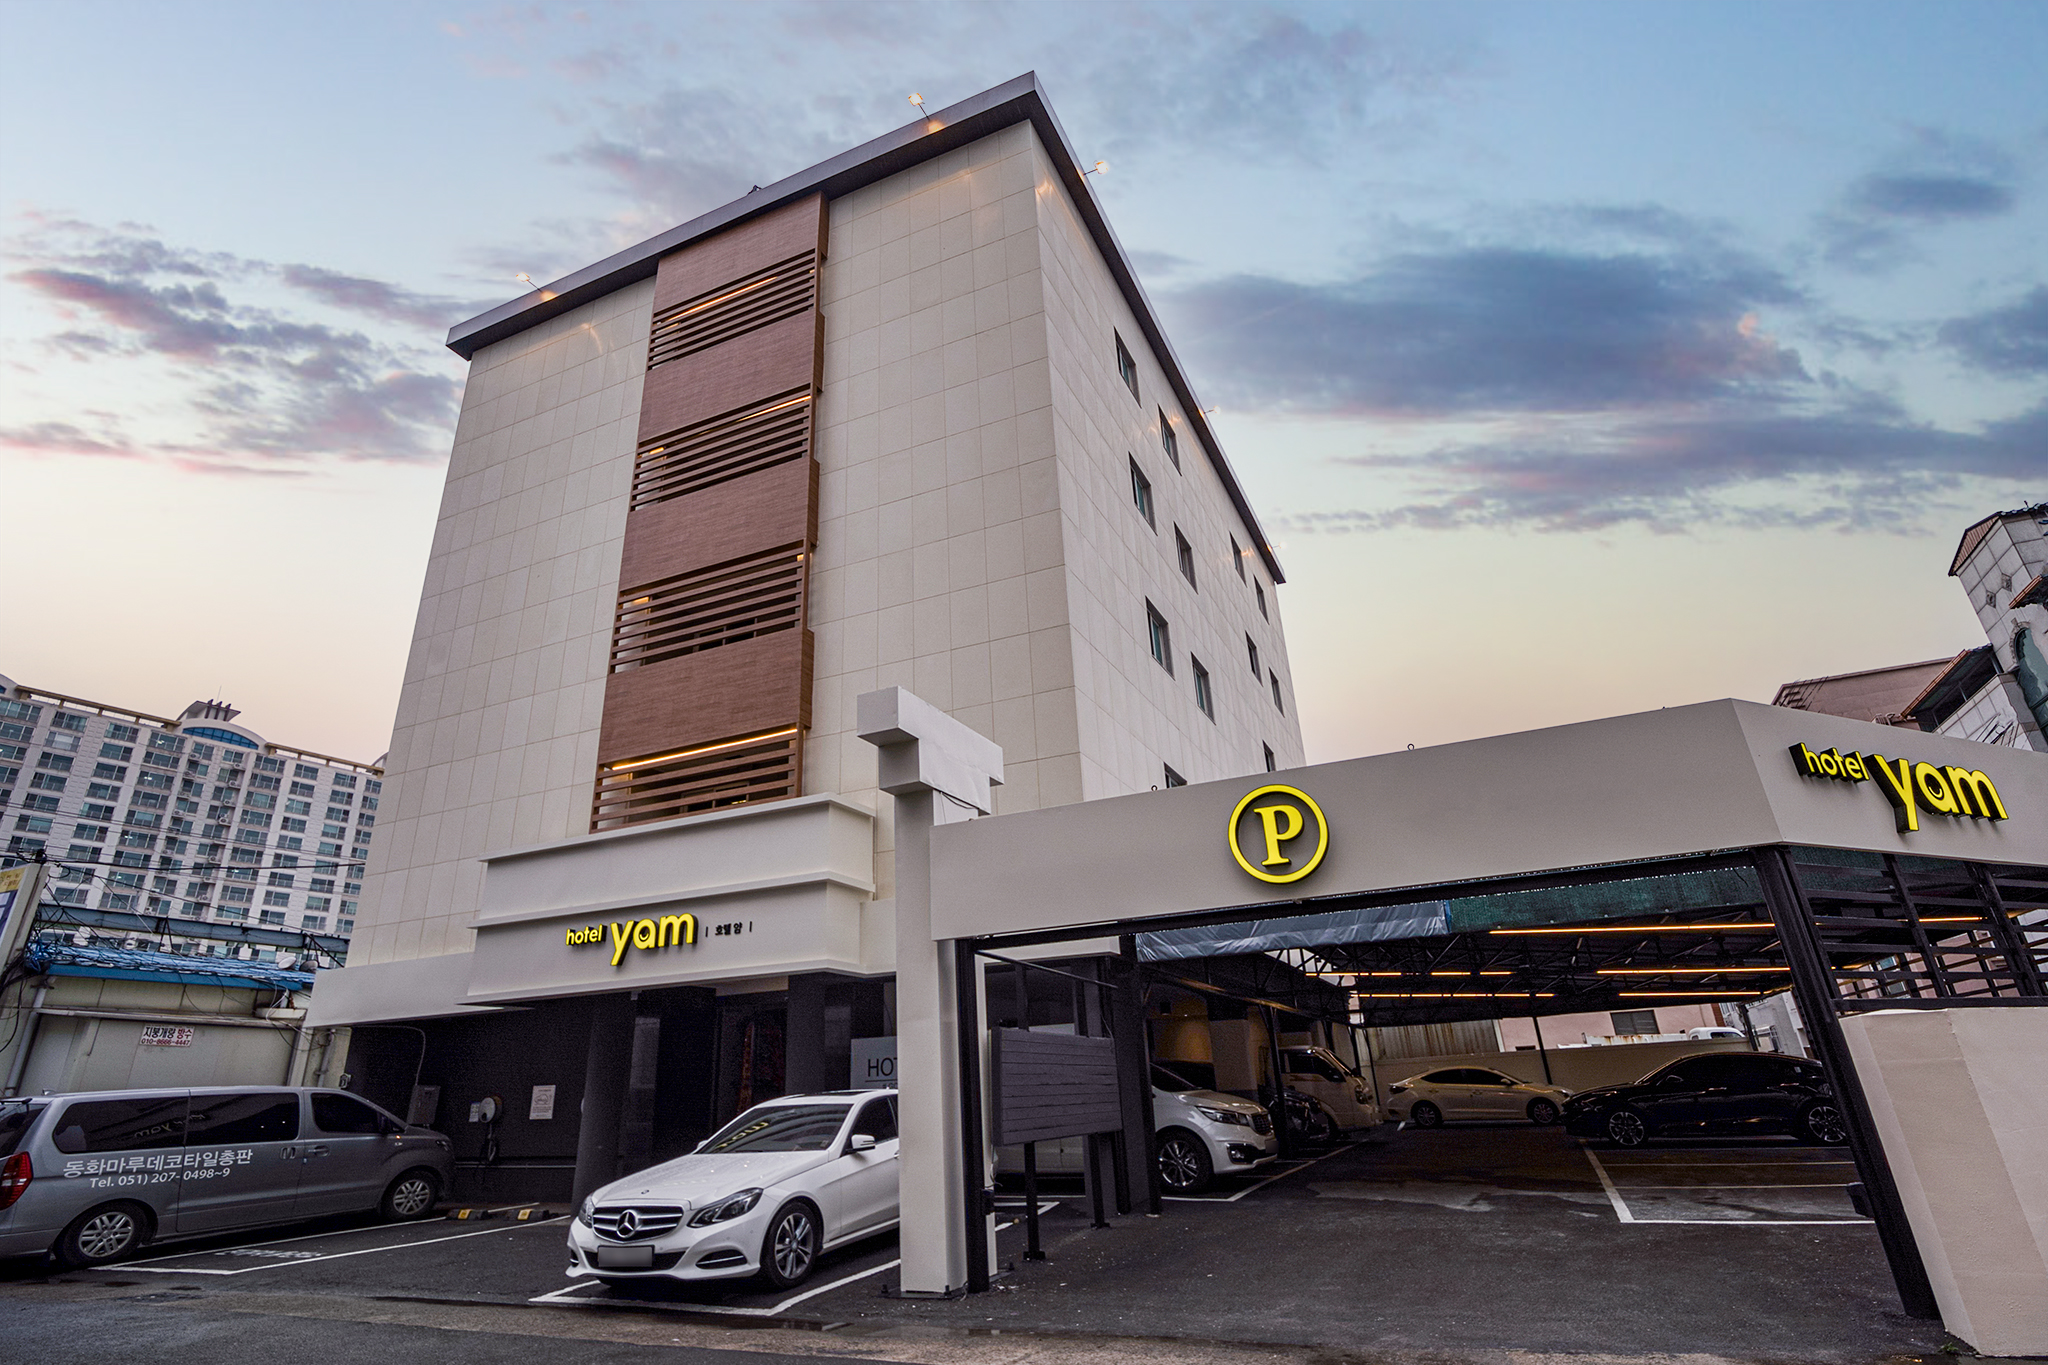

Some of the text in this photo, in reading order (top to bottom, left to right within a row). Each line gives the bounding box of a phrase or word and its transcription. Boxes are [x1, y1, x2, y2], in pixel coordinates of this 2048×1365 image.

[1798, 742, 2010, 832] hotel yam
[1253, 804, 1304, 866] P
[565, 912, 698, 966] hotel yam
[90, 1177, 115, 1188] Tel.
[118, 1174, 148, 1186] 051)
